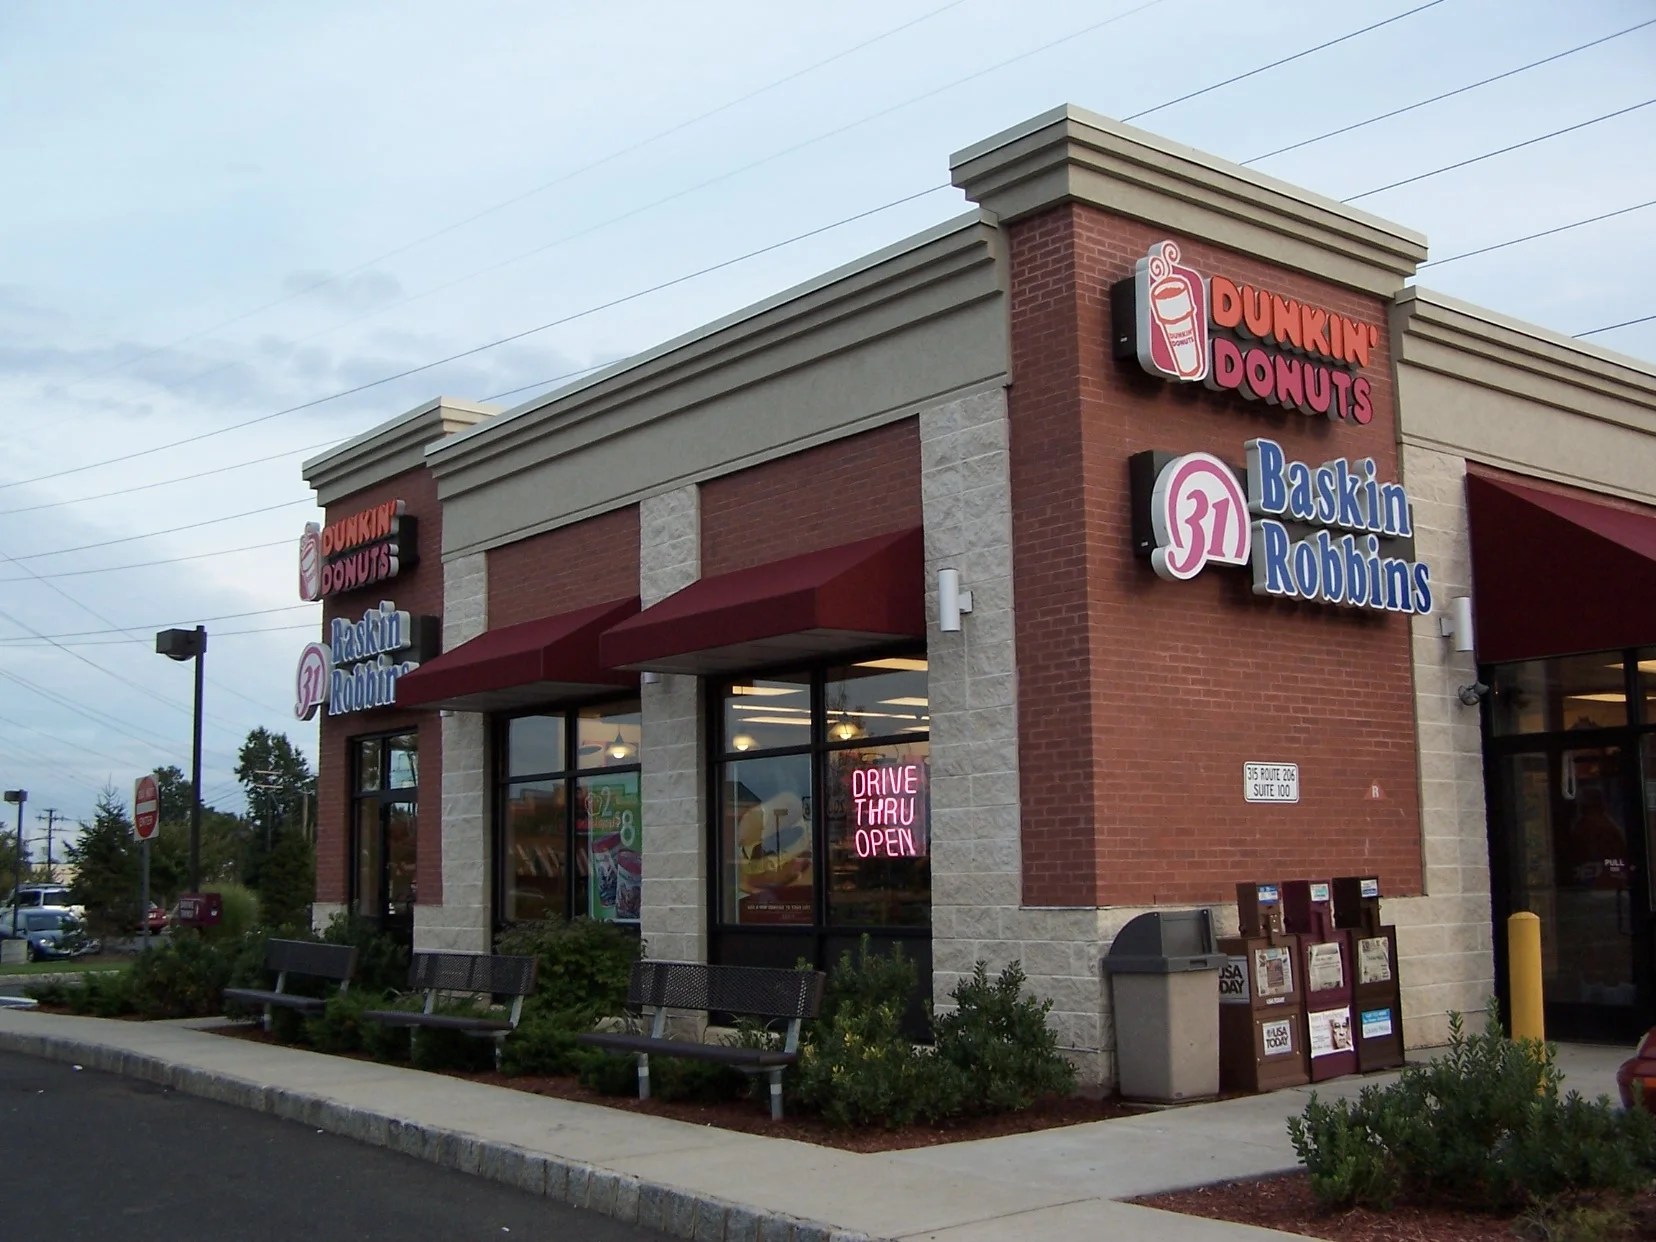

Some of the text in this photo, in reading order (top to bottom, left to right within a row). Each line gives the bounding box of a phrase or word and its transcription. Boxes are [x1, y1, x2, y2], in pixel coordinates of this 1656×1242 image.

[1211, 275, 1379, 368] DUNKIN'
[1171, 336, 1194, 346] DONUTS
[1211, 337, 1374, 425] DONUTS
[1256, 438, 1412, 537] Baskin
[322, 499, 398, 558] DUNKIN'
[1167, 488, 1231, 574] 31
[321, 543, 392, 596] DONUTS
[1261, 520, 1433, 615] Robbins
[331, 600, 401, 666] Baskin
[296, 663, 322, 719] 31
[852, 765, 918, 798] DRIVE
[1253, 783, 1291, 797] SUITE 100
[1260, 768, 1281, 781] ROUTE
[1282, 768, 1296, 782] 206
[1371, 785, 1380, 799] R
[139, 815, 153, 828] ENTER
[854, 797, 916, 826] THRU
[854, 828, 916, 858] OPEN
[1604, 858, 1625, 867] PULL
[1219, 980, 1245, 995] DAY
[1266, 1036, 1289, 1049] TODAY
[1273, 1026, 1288, 1038] USA
